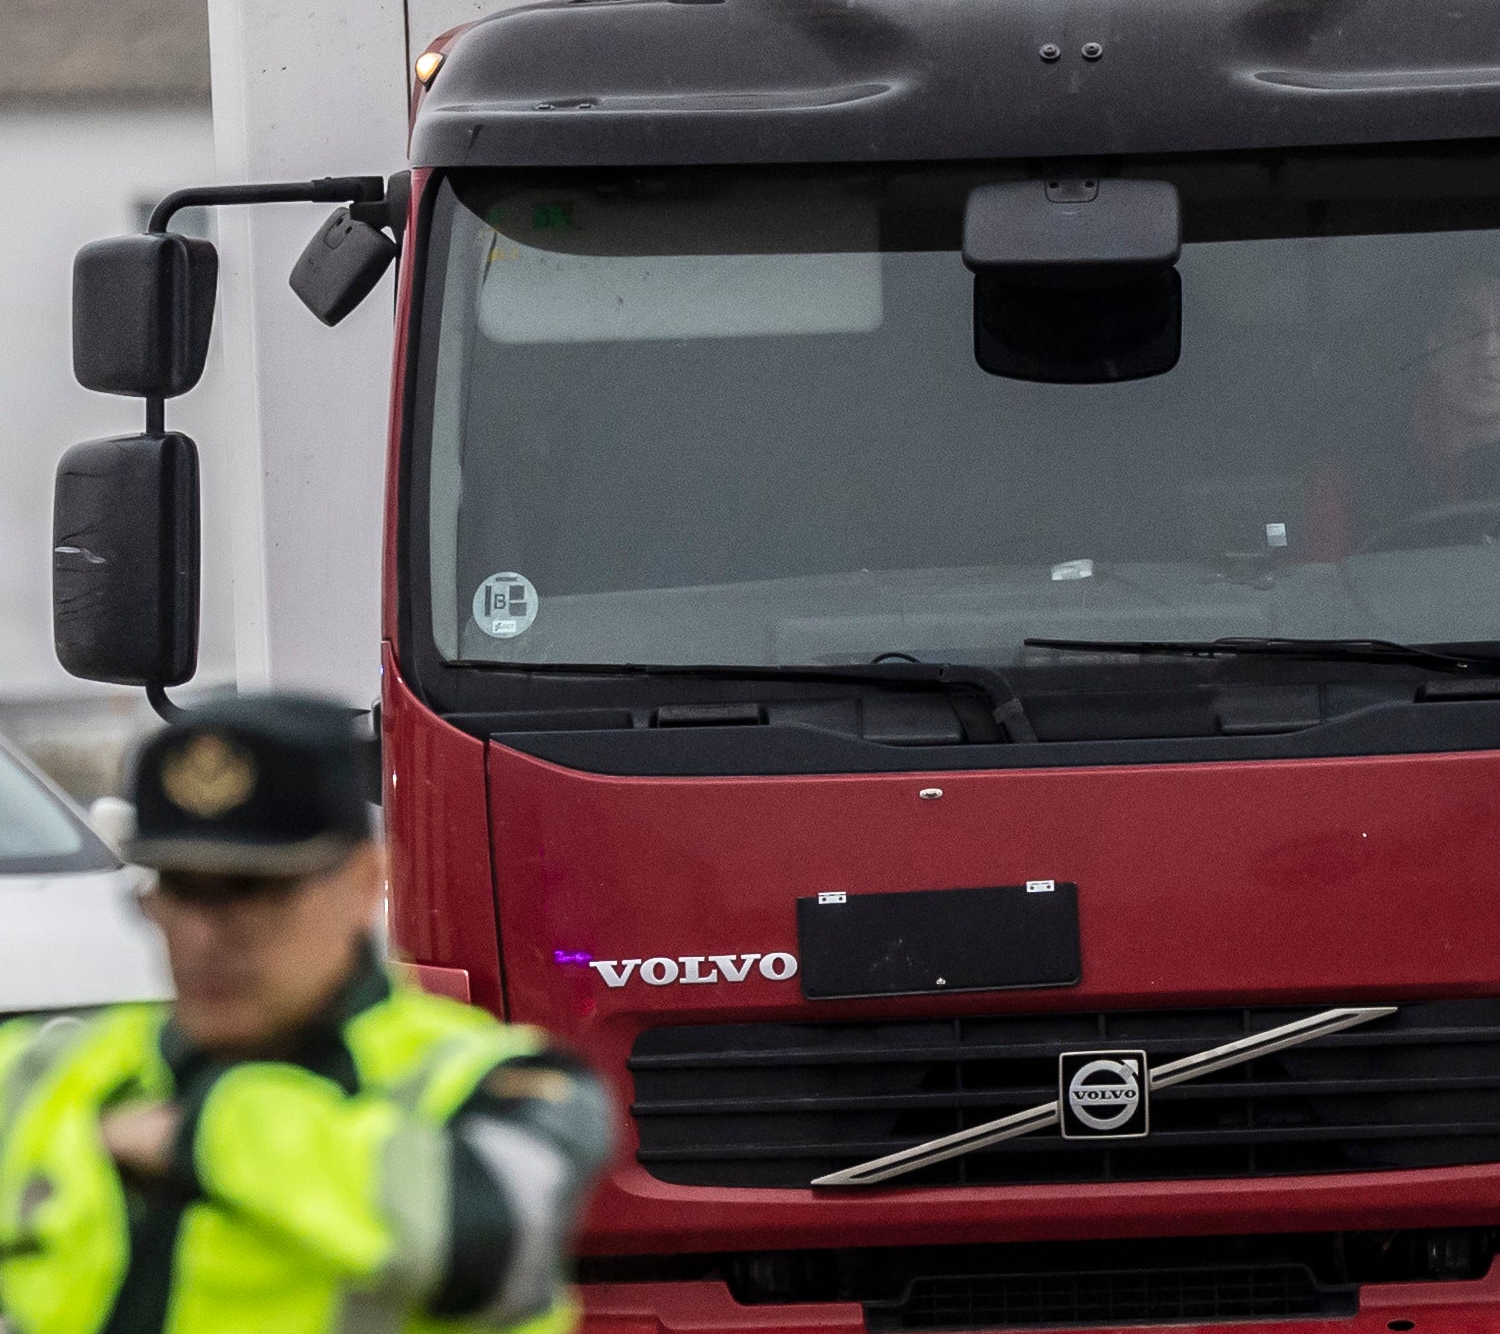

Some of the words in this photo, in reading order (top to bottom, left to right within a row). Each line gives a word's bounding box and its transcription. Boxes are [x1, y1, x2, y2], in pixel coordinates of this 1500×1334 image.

[494, 593, 506, 610] B
[589, 951, 798, 988] VOLVO
[1072, 1089, 1137, 1100] VOLVO
